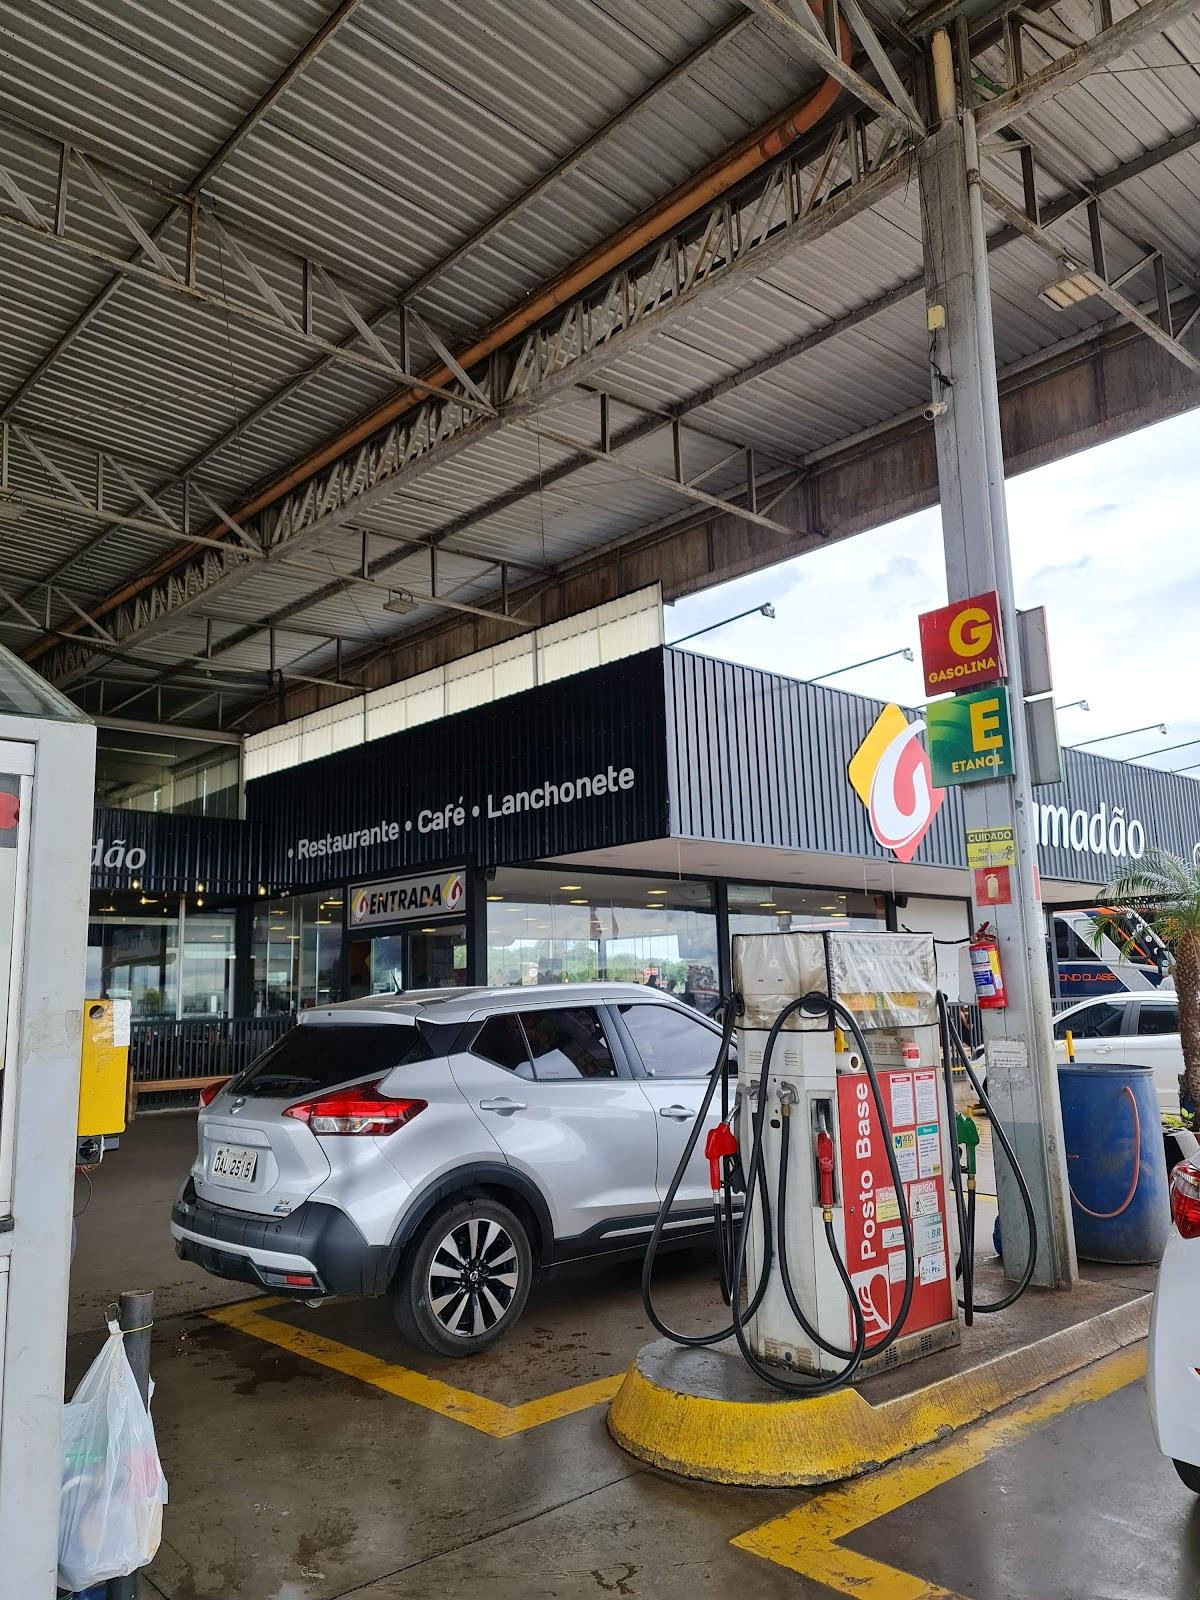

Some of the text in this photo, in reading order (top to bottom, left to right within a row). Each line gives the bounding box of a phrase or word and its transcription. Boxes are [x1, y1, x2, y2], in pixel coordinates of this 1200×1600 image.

[949, 607, 992, 657] G
[928, 657, 996, 684] GASOLINA
[970, 698, 1003, 752] E
[952, 753, 1003, 773] ETANOL
[298, 765, 634, 860] Restaurante Café Lanchonete
[968, 831, 1011, 842] CUIDADO
[369, 883, 442, 915] ENTRADA
[856, 1082, 876, 1261] Posto Base
